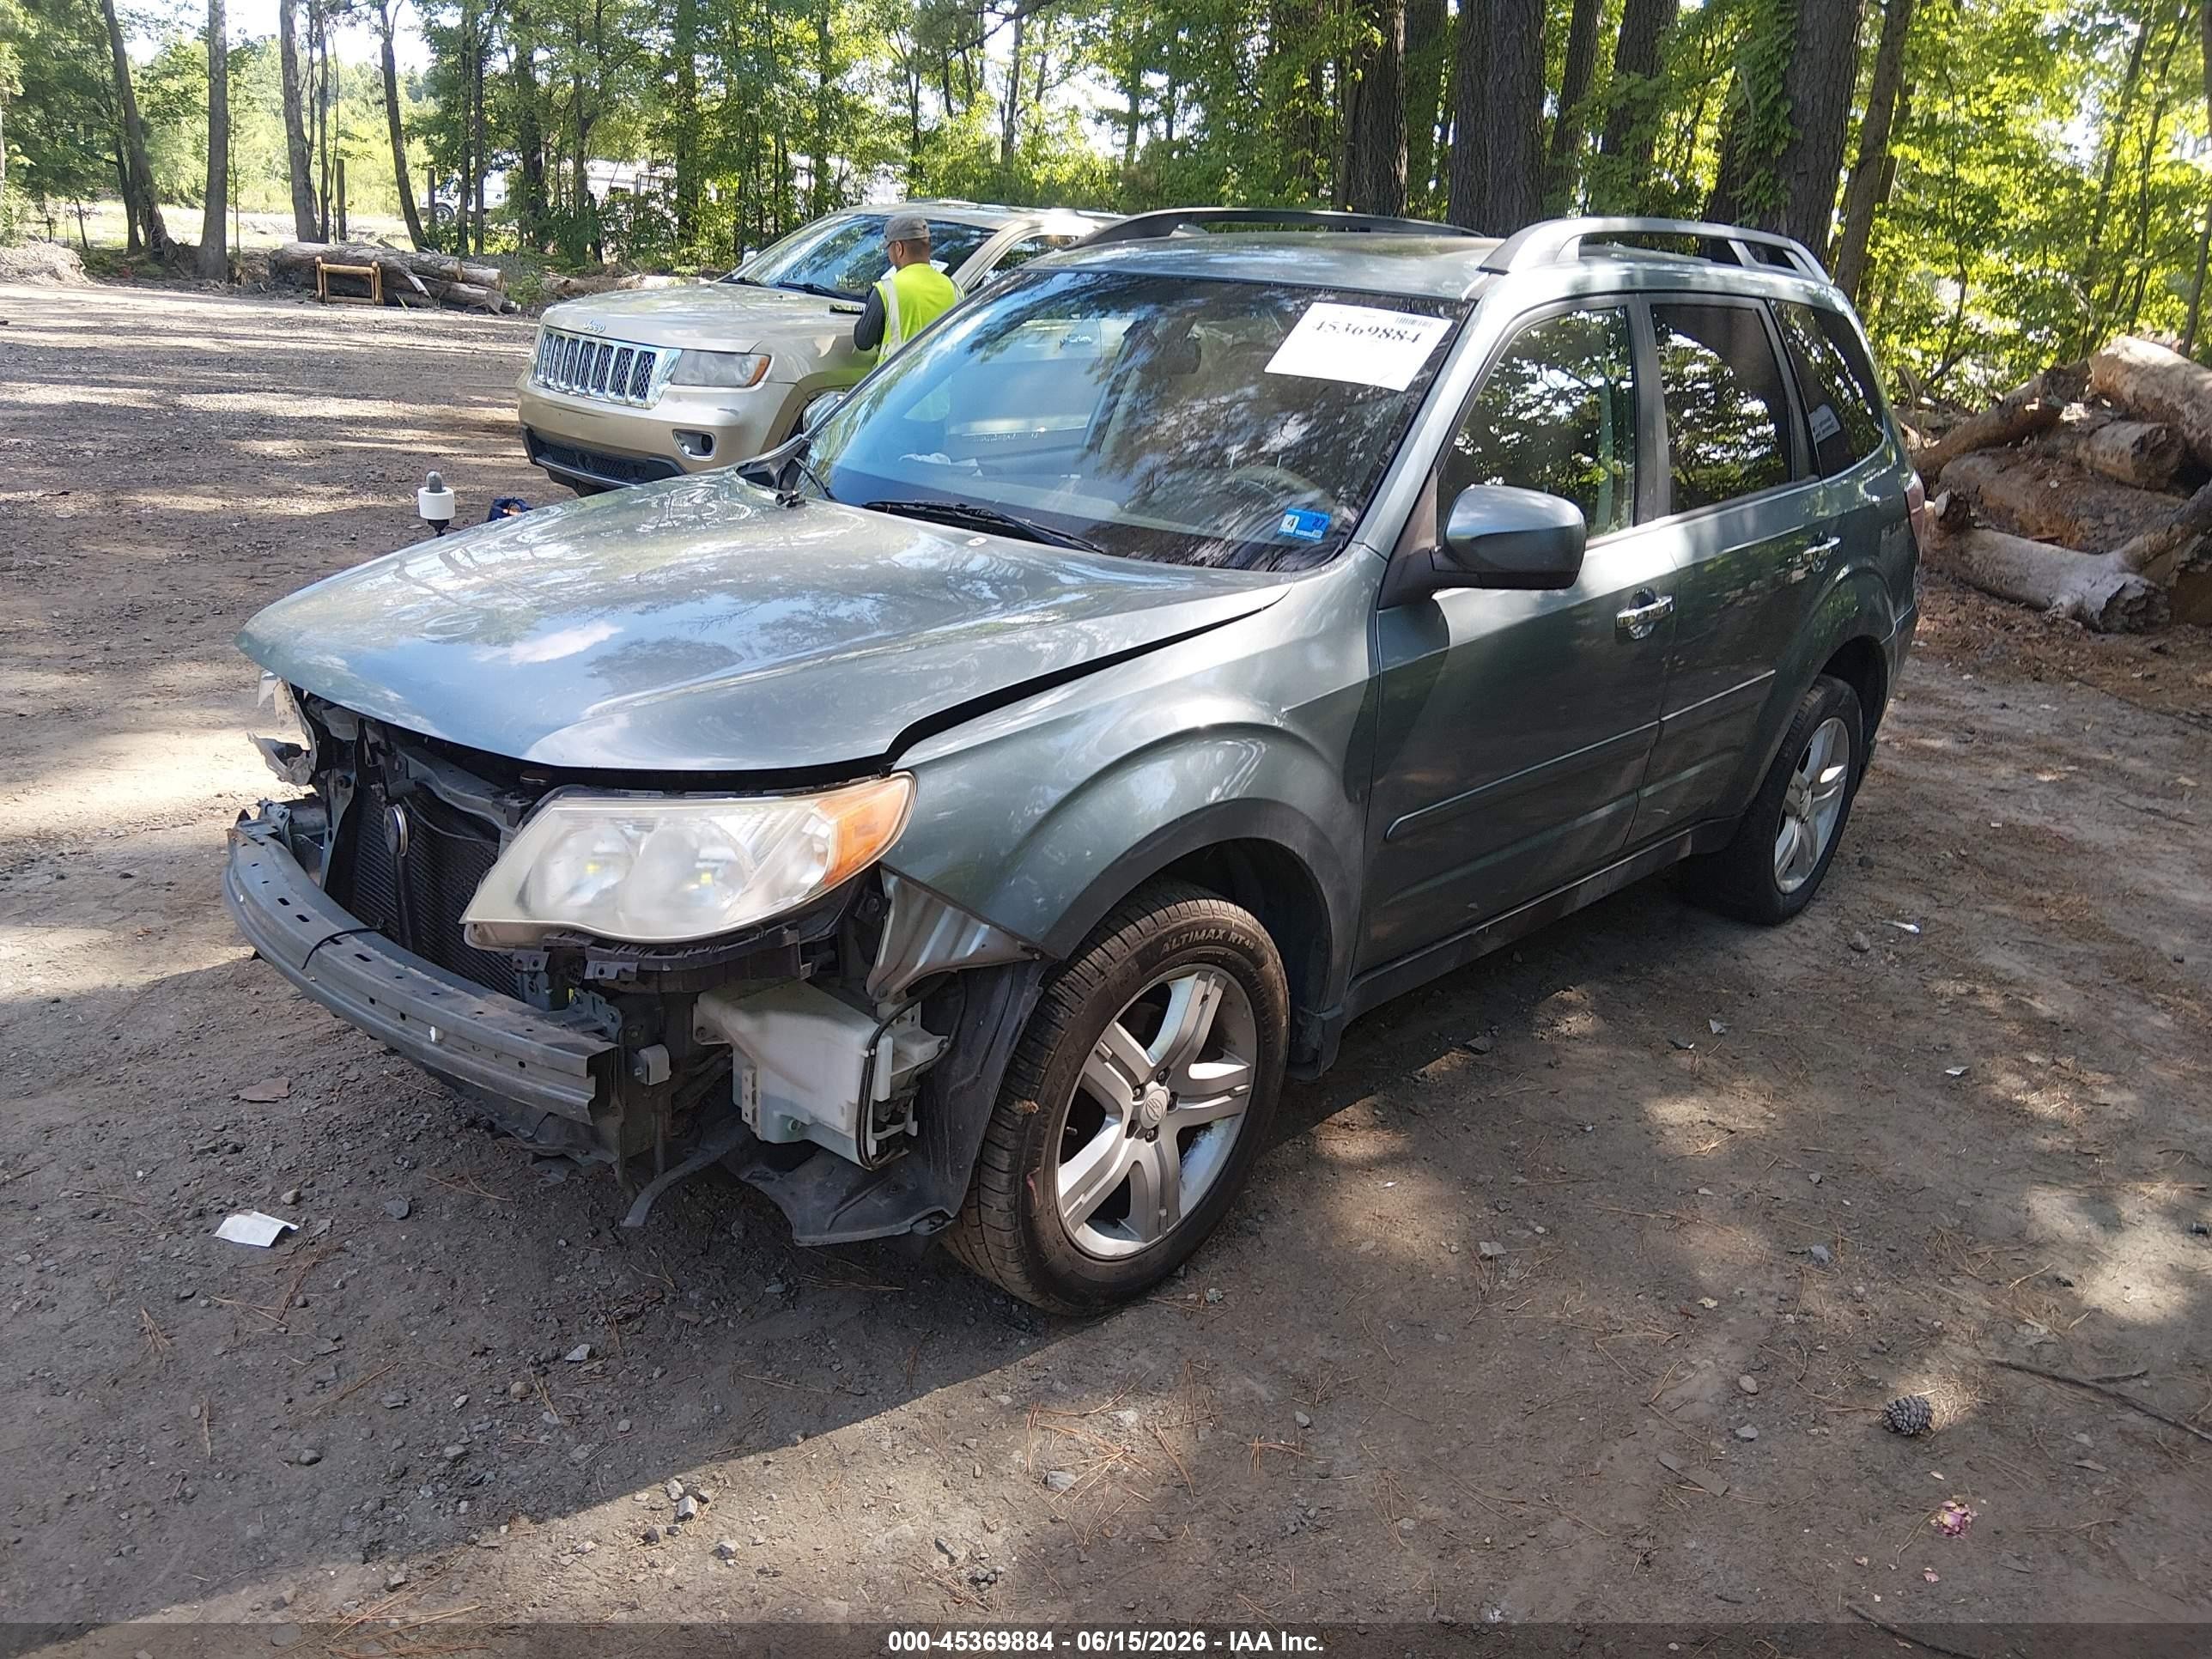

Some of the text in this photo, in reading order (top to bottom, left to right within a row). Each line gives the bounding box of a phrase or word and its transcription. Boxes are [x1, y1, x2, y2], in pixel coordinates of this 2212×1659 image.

[583, 319, 606, 335] Jeep
[1312, 319, 1423, 344] 45369884
[1287, 517, 1297, 528] 4
[1161, 927, 1226, 955] ALTIMAX
